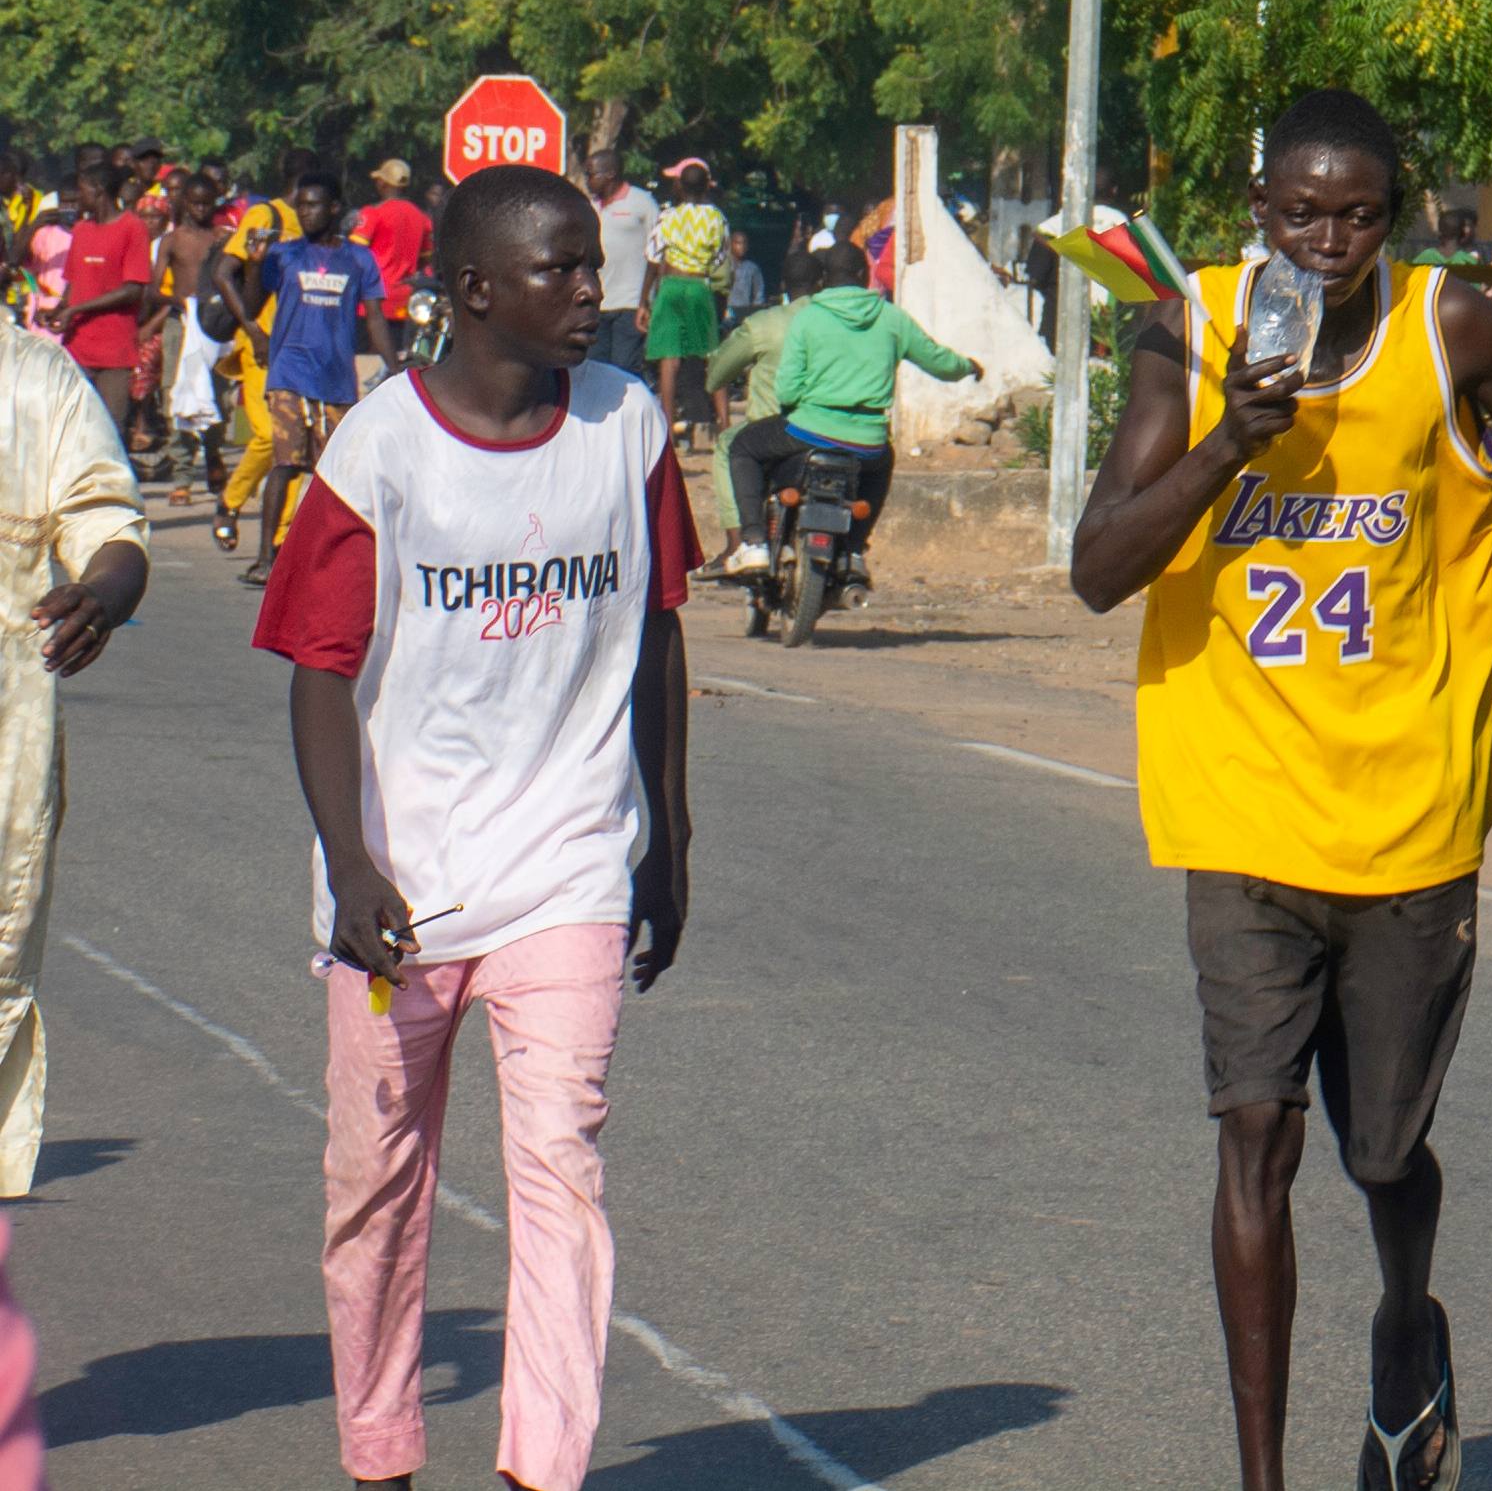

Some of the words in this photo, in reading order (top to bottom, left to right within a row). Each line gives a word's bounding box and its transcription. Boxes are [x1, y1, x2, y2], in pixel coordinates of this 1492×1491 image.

[463, 123, 547, 162] STOP
[1213, 472, 1411, 548] LAKERS
[416, 550, 620, 612] TCHIROMA
[1246, 562, 1376, 668] 24
